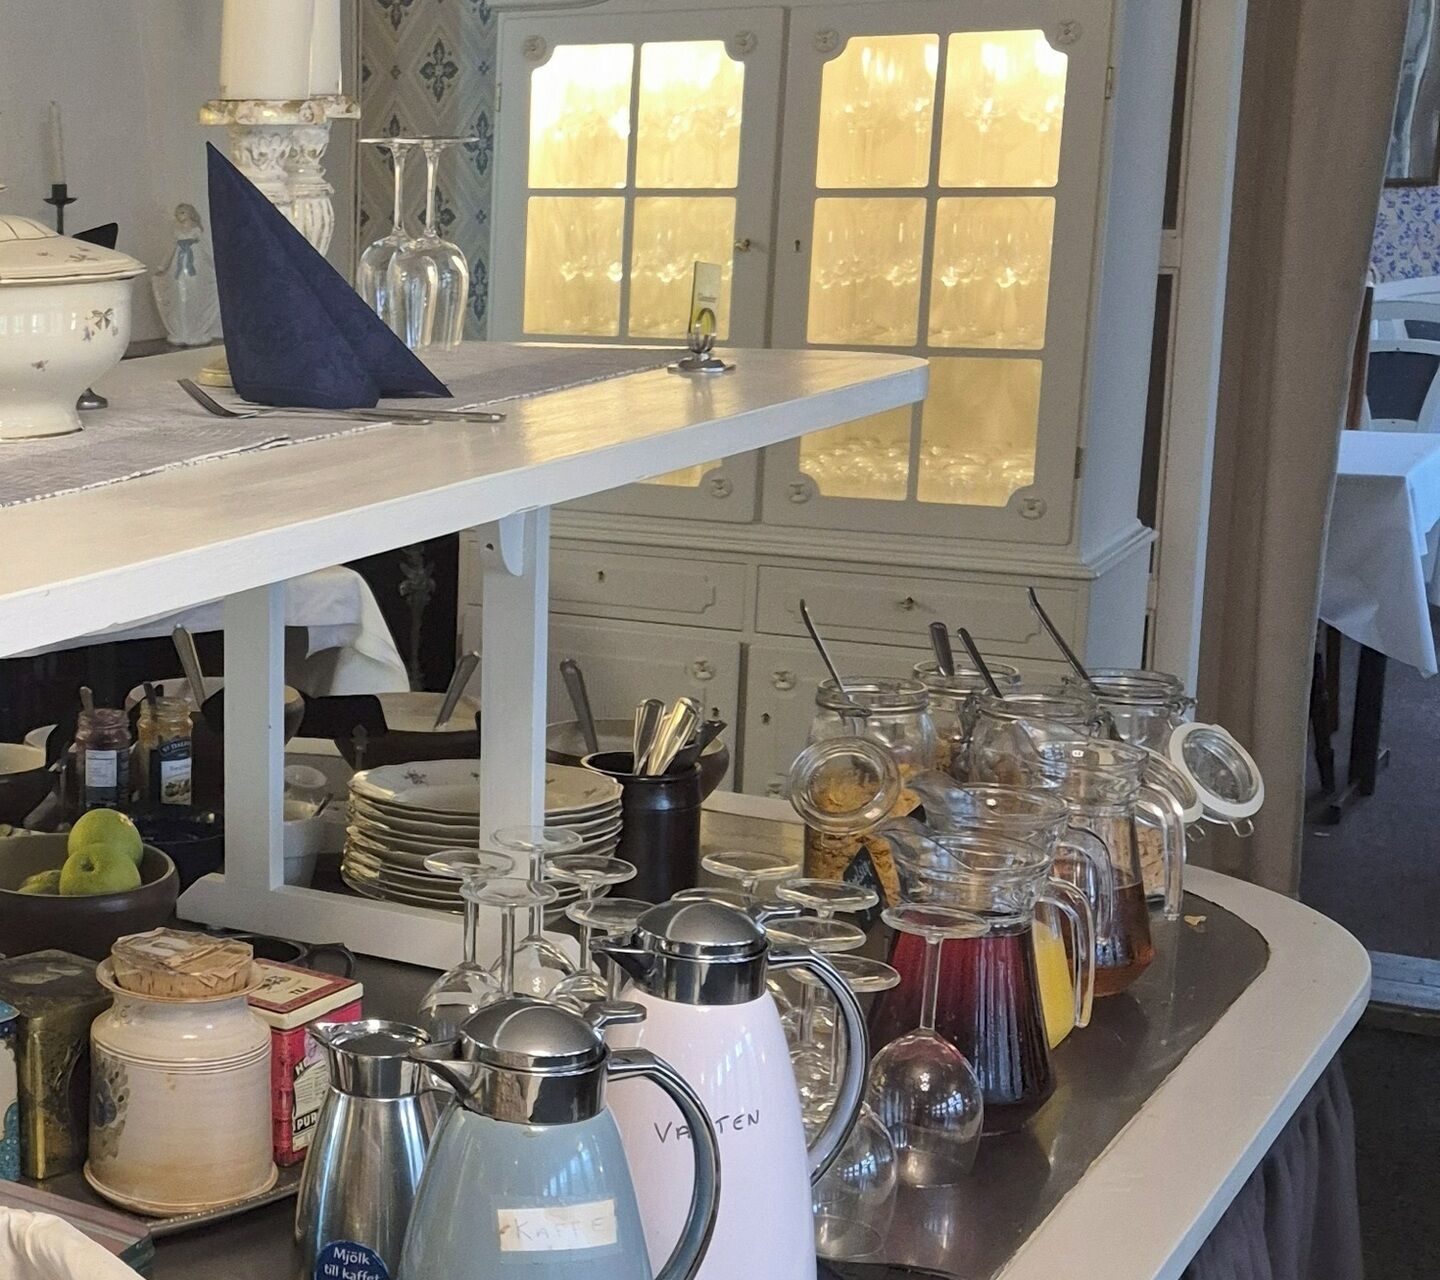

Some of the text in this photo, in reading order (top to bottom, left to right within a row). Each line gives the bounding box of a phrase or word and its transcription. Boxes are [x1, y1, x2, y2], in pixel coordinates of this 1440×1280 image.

[297, 1111, 318, 1129] PUR
[654, 1109, 760, 1143] VATEN
[333, 1247, 370, 1266] Mjölk
[324, 1263, 339, 1277] till
